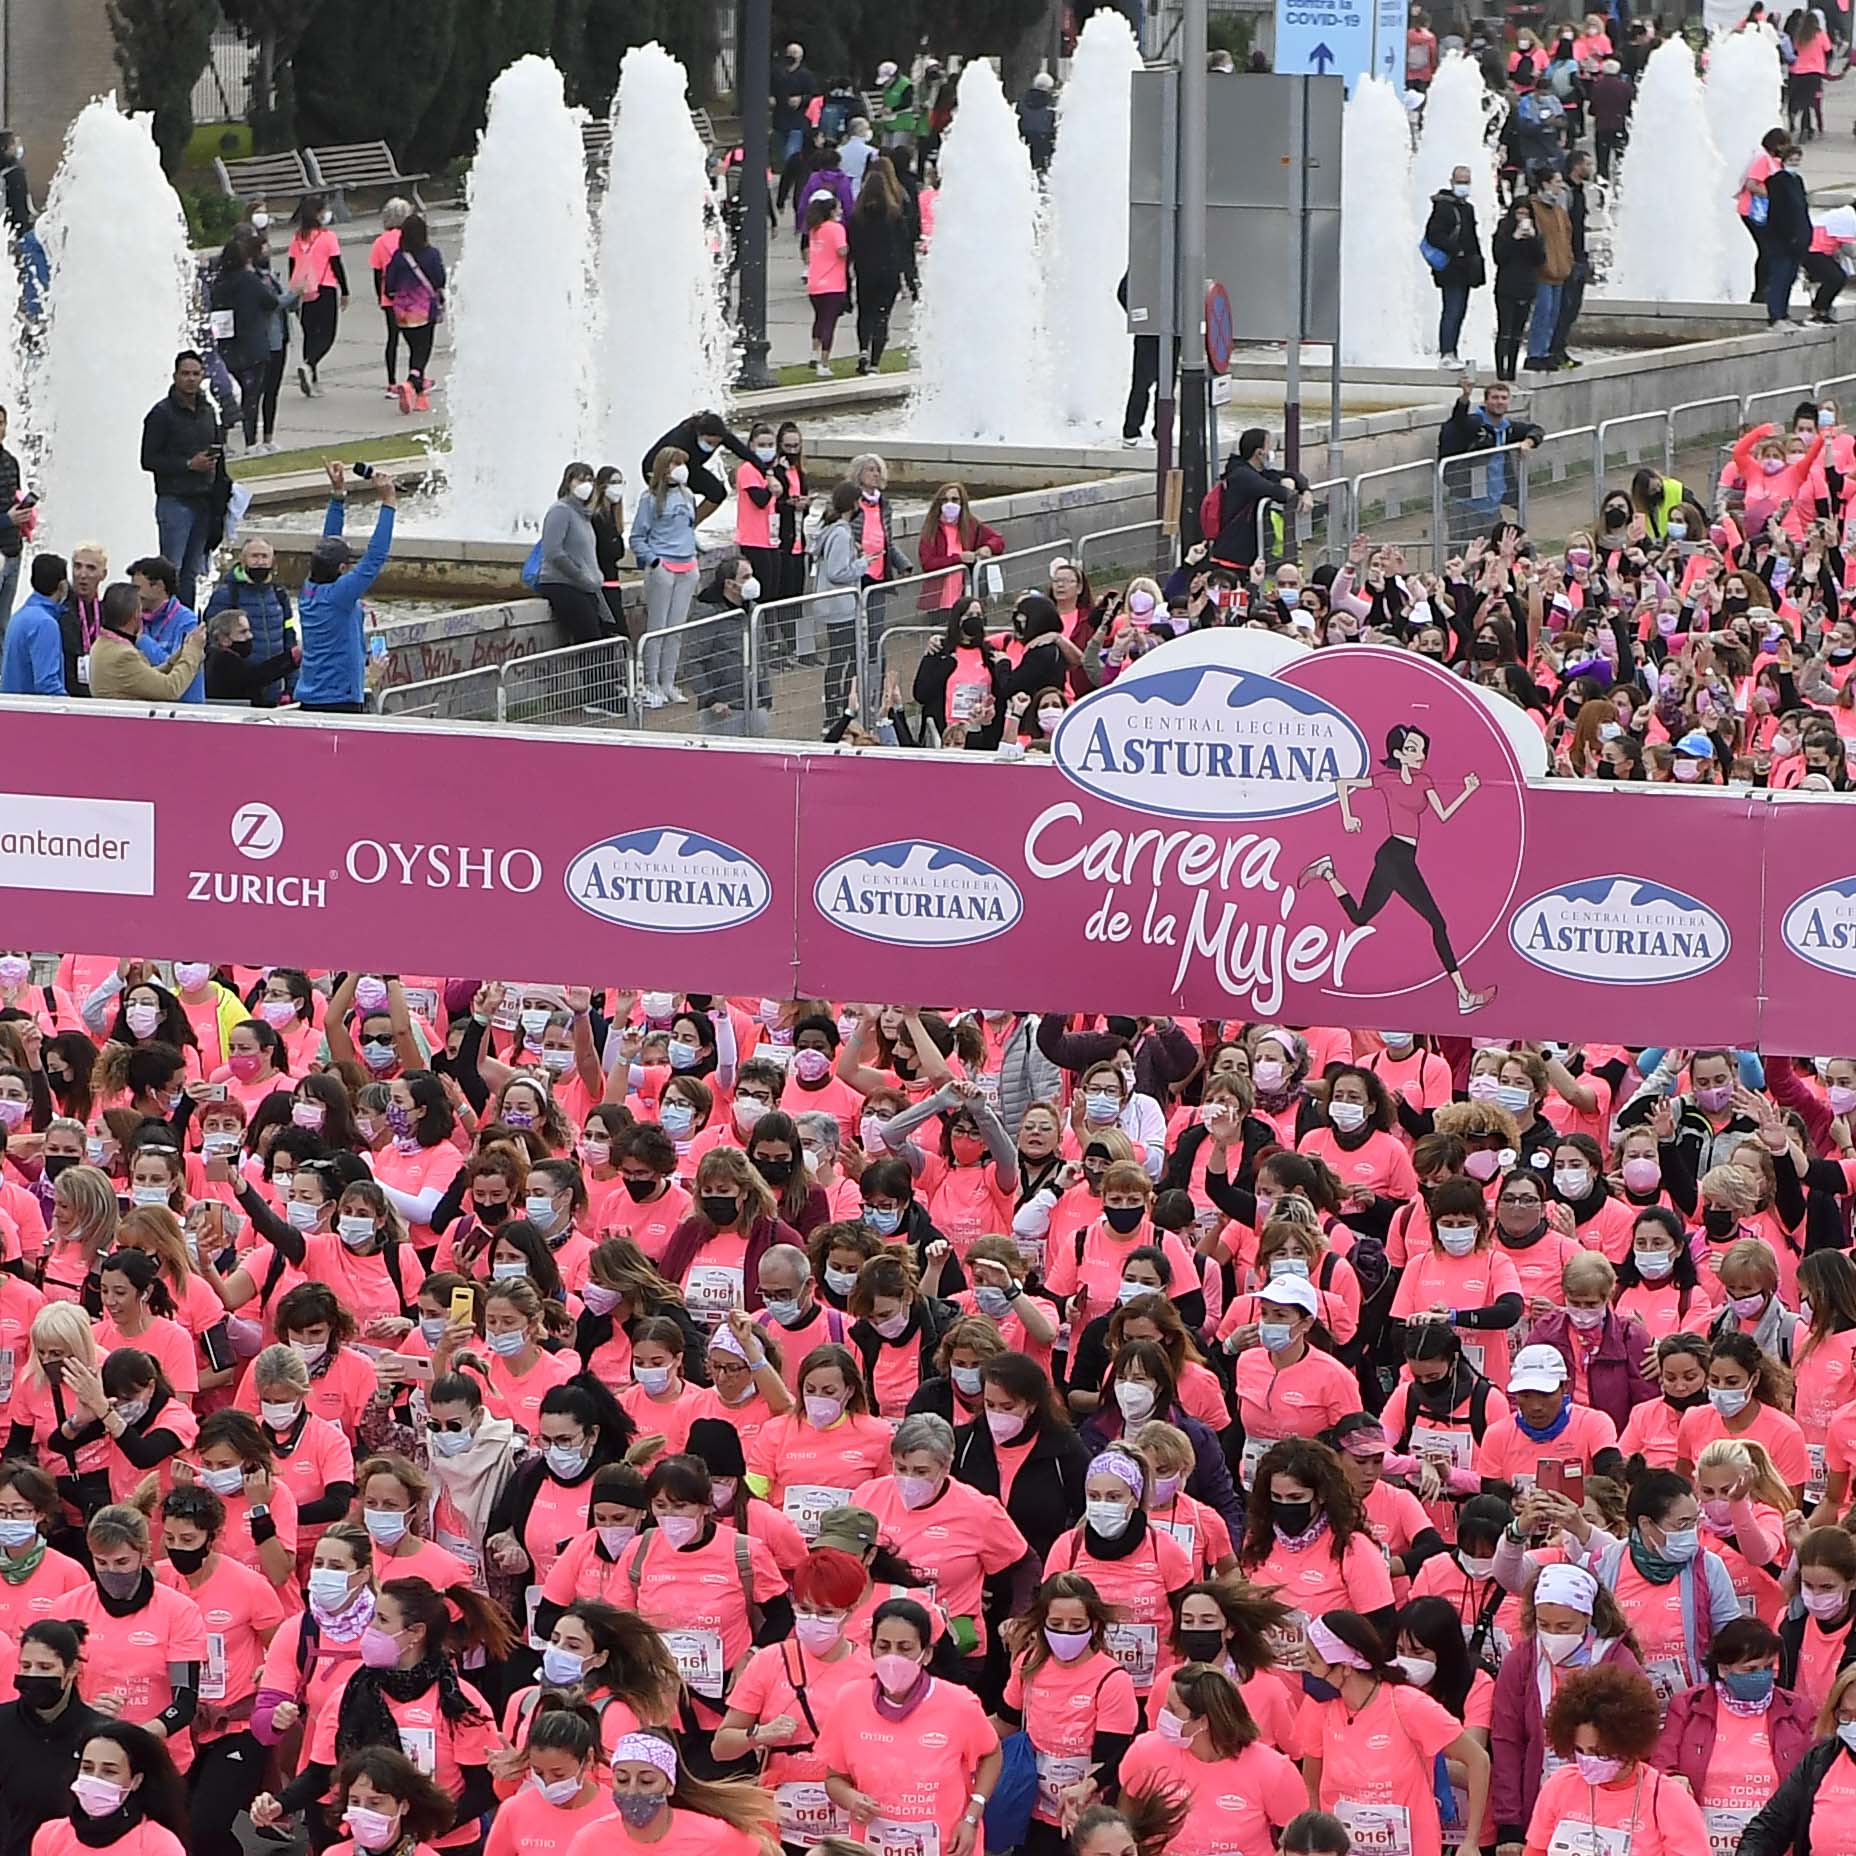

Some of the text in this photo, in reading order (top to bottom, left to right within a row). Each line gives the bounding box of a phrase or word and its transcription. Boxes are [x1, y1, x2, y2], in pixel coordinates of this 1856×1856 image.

[1286, 12, 1361, 27] COVID-19
[1127, 715, 1334, 738] CENTRAL LECHERA
[1078, 715, 1342, 783] ASTURIANA
[1023, 801, 1279, 890] Carrera
[345, 838, 542, 894] OYSHO
[186, 872, 327, 908] ZURICH
[579, 860, 755, 908] ASTURIANA
[830, 872, 1006, 922] ASTURIANA
[1560, 909, 1706, 928] CENTRAL LECHERA
[1526, 912, 1712, 963] ASTURIANA
[1085, 885, 1377, 1016] de la Mujer
[703, 1285, 732, 1301] 016
[801, 1508, 822, 1520] 01
[675, 1656, 700, 1670] 16
[915, 1781, 939, 1793] POR
[1745, 1774, 1771, 1785] POR
[1729, 1785, 1771, 1797] TODAS
[797, 1809, 827, 1821] 016
[1355, 1831, 1386, 1843] 016
[1710, 1836, 1740, 1849] 016
